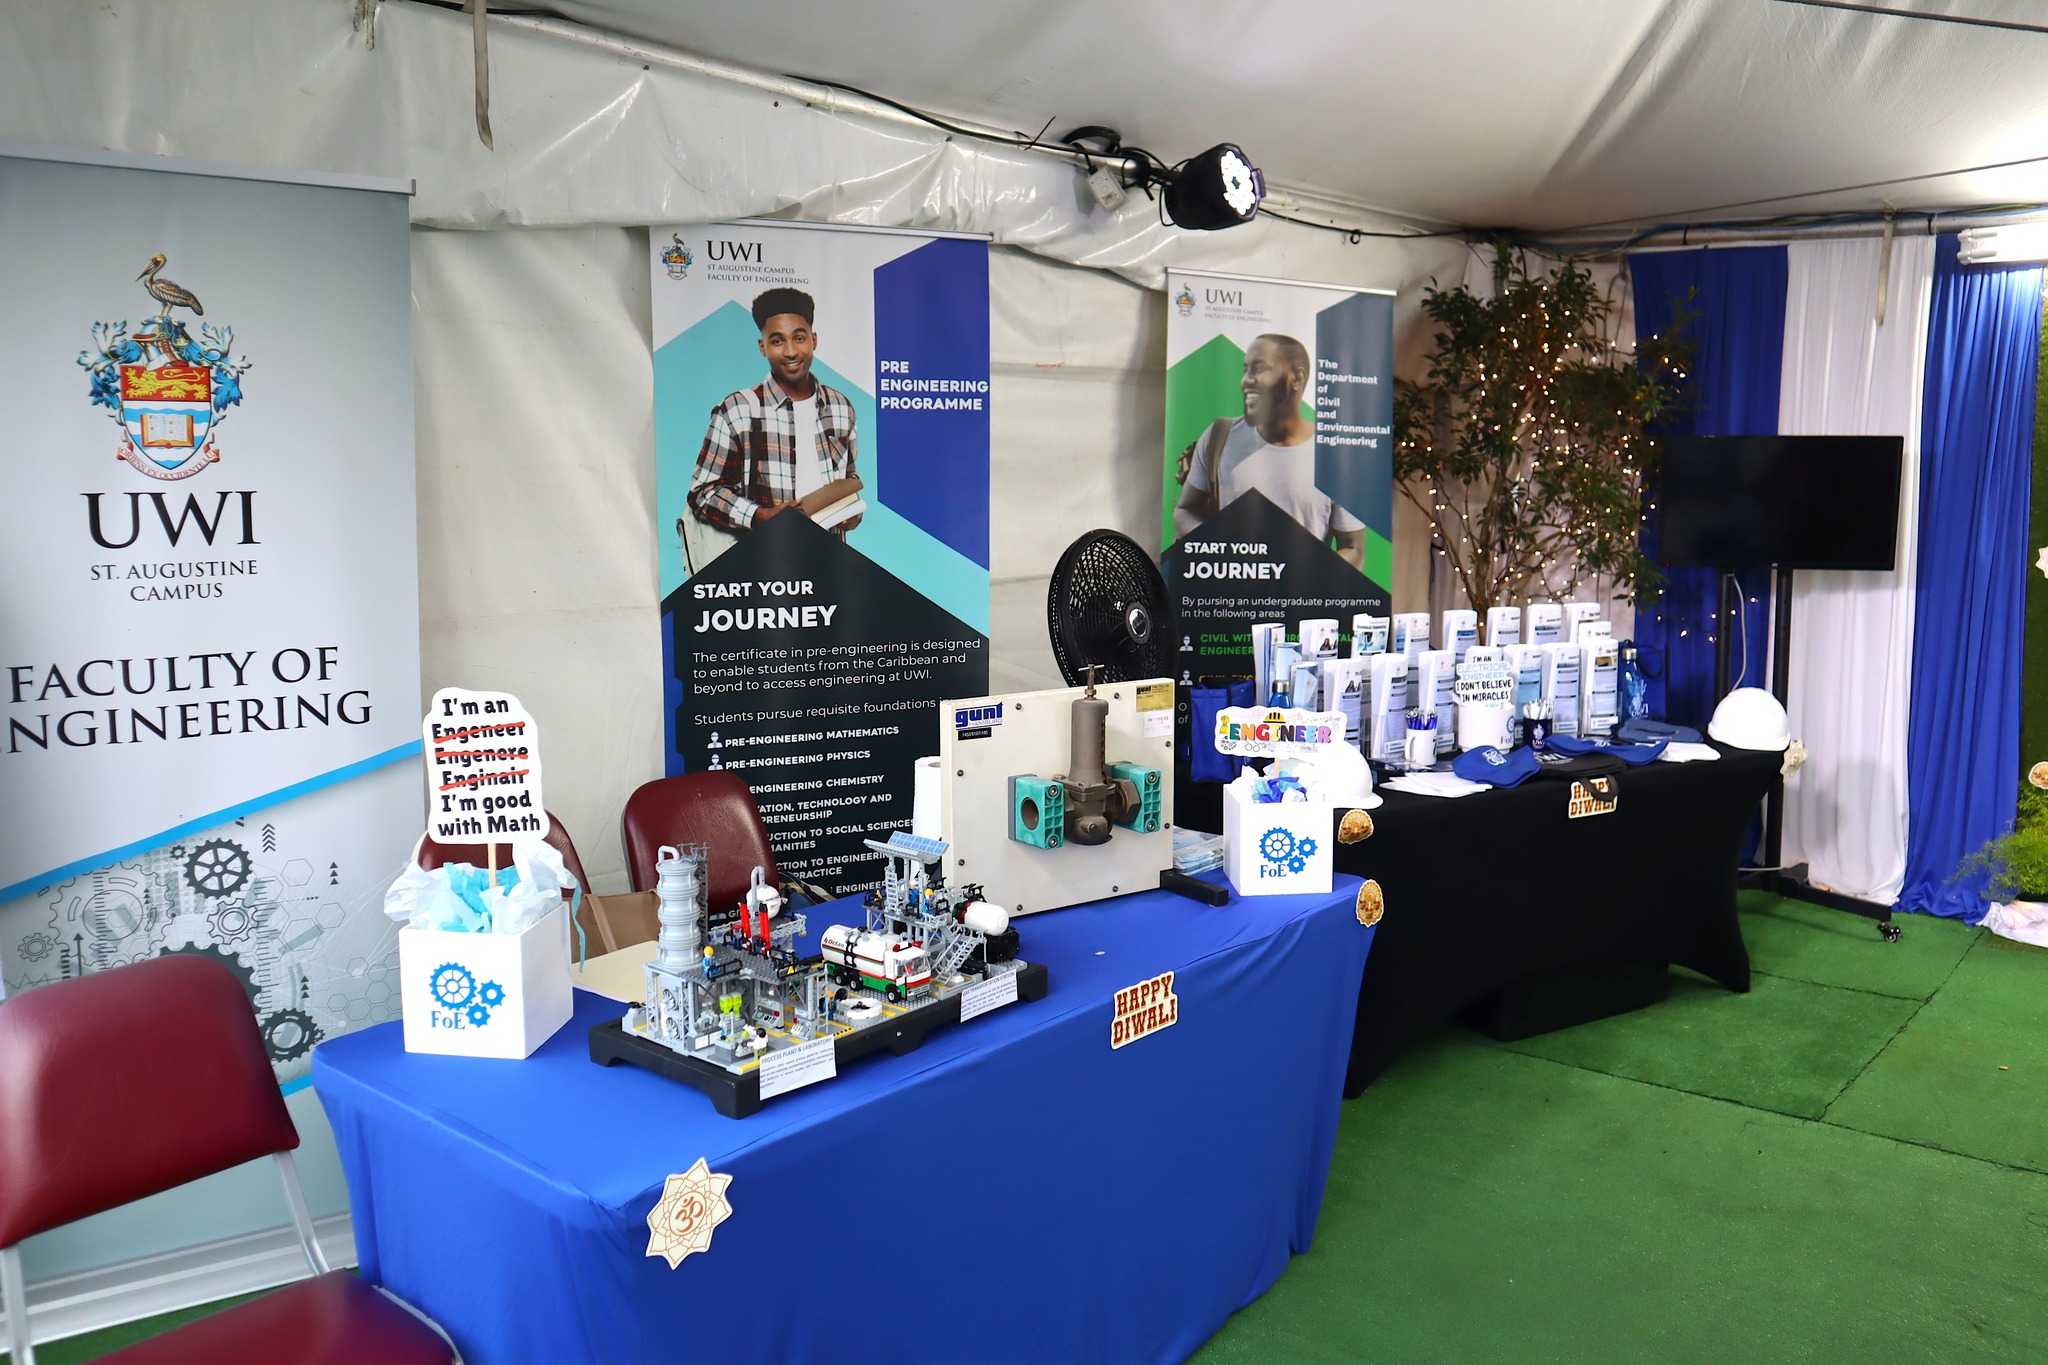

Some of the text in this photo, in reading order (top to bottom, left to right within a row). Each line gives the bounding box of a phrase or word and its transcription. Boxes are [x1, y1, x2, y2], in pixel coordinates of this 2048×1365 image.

[706, 240, 763, 263] UWI
[718, 265, 762, 273] AUGUSTINE
[755, 276, 809, 284] ENGINEERING
[1205, 288, 1243, 306] UWI
[880, 360, 909, 374] PRE
[1318, 359, 1338, 369] The
[880, 379, 989, 393] ENGINEERING
[1318, 372, 1378, 385] Department
[1317, 384, 1329, 393] of
[880, 397, 983, 411] PROGRAMME
[1317, 397, 1341, 407] Civil
[1317, 410, 1337, 419] and
[1317, 422, 1390, 434] Environmental
[1316, 435, 1377, 448] Engineering
[80, 489, 262, 550] UWI
[1184, 542, 1268, 555] START YOUR
[90, 559, 258, 582] ST. AUGUSTINE
[1183, 561, 1286, 580] JOURNEY
[129, 582, 224, 602] CAMPUS
[693, 580, 814, 600] START YOUR
[1182, 596, 1381, 608] By pursing an undergraduate programme
[693, 604, 838, 633] JOURNEY
[1181, 609, 1285, 619] in the following areas
[1200, 634, 1253, 643] CIVIL WIT
[692, 638, 981, 663] The certificate in pre-engineering is designed
[1200, 646, 1255, 655] ENGINEER
[6, 646, 338, 703] FACULTY OF
[693, 653, 966, 679] to enable students from the Caribbean and
[1457, 662, 1511, 673] ELECTRICAL
[693, 669, 932, 696] beyond to access engineering at UWI.
[1461, 681, 1480, 691] DON'T
[1482, 679, 1512, 690] BELIEVE
[1462, 672, 1504, 680] ENGINEER
[1462, 691, 1509, 702] IN MIRACLES
[442, 698, 509, 716] I'm an
[694, 697, 937, 726] Students pursue requisite foundations
[0, 690, 373, 754] NGINEERING
[431, 722, 525, 744] Engeneer
[725, 726, 900, 748] PRE-ENGINEERING MATHEMATICS
[1229, 723, 1332, 743] ENGINEER
[434, 747, 528, 767] Engenere
[725, 750, 871, 770] PRE-ENGINEERING PHYSICS
[440, 767, 527, 791] Enginair
[749, 775, 885, 794] ENGINEERING CHEMISTRY
[441, 790, 532, 814] I'm good
[757, 793, 892, 813] ATION, TECHNOLOGY AND
[437, 813, 540, 836] with Math
[767, 830, 807, 841] UCTION
[810, 828, 823, 838] TO
[826, 824, 864, 836] SOCIAL
[811, 858, 824, 867] TO
[1260, 863, 1287, 878] FoE
[1117, 974, 1172, 1018] HAPPY
[431, 1010, 466, 1030] FoE
[1113, 999, 1176, 1045] DIWALI
[761, 1053, 782, 1064] PROCESS
[783, 1048, 797, 1058] PLANT
[803, 1037, 832, 1051] LABORATORY
